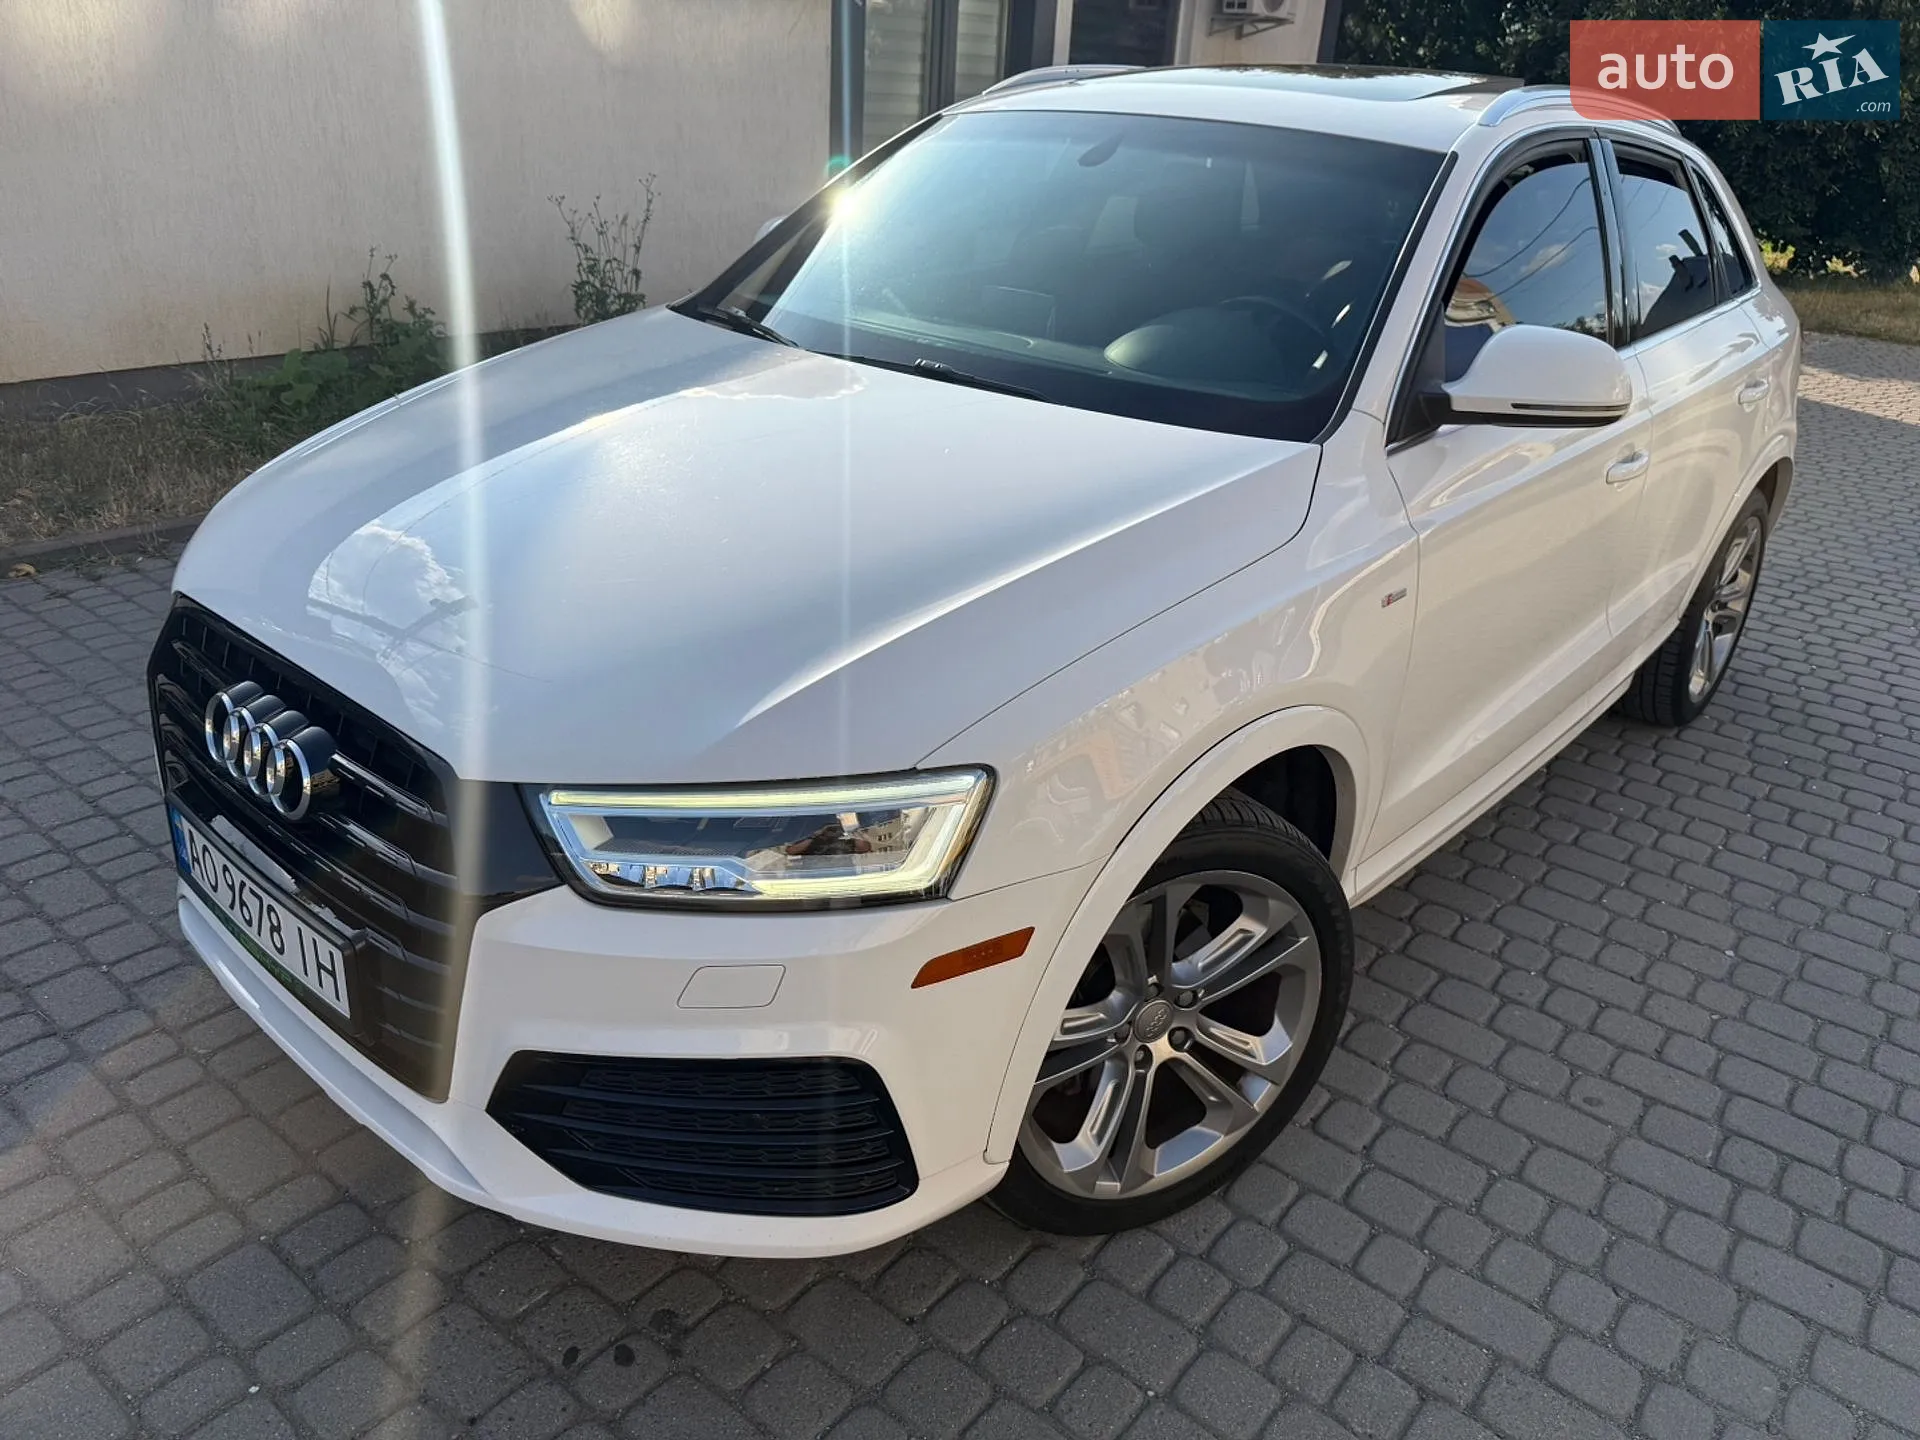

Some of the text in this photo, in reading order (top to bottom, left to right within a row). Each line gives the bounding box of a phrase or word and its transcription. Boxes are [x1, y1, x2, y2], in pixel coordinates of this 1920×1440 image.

[188, 828, 218, 893] AO
[222, 863, 286, 956] 9678
[297, 926, 341, 1002] IH
